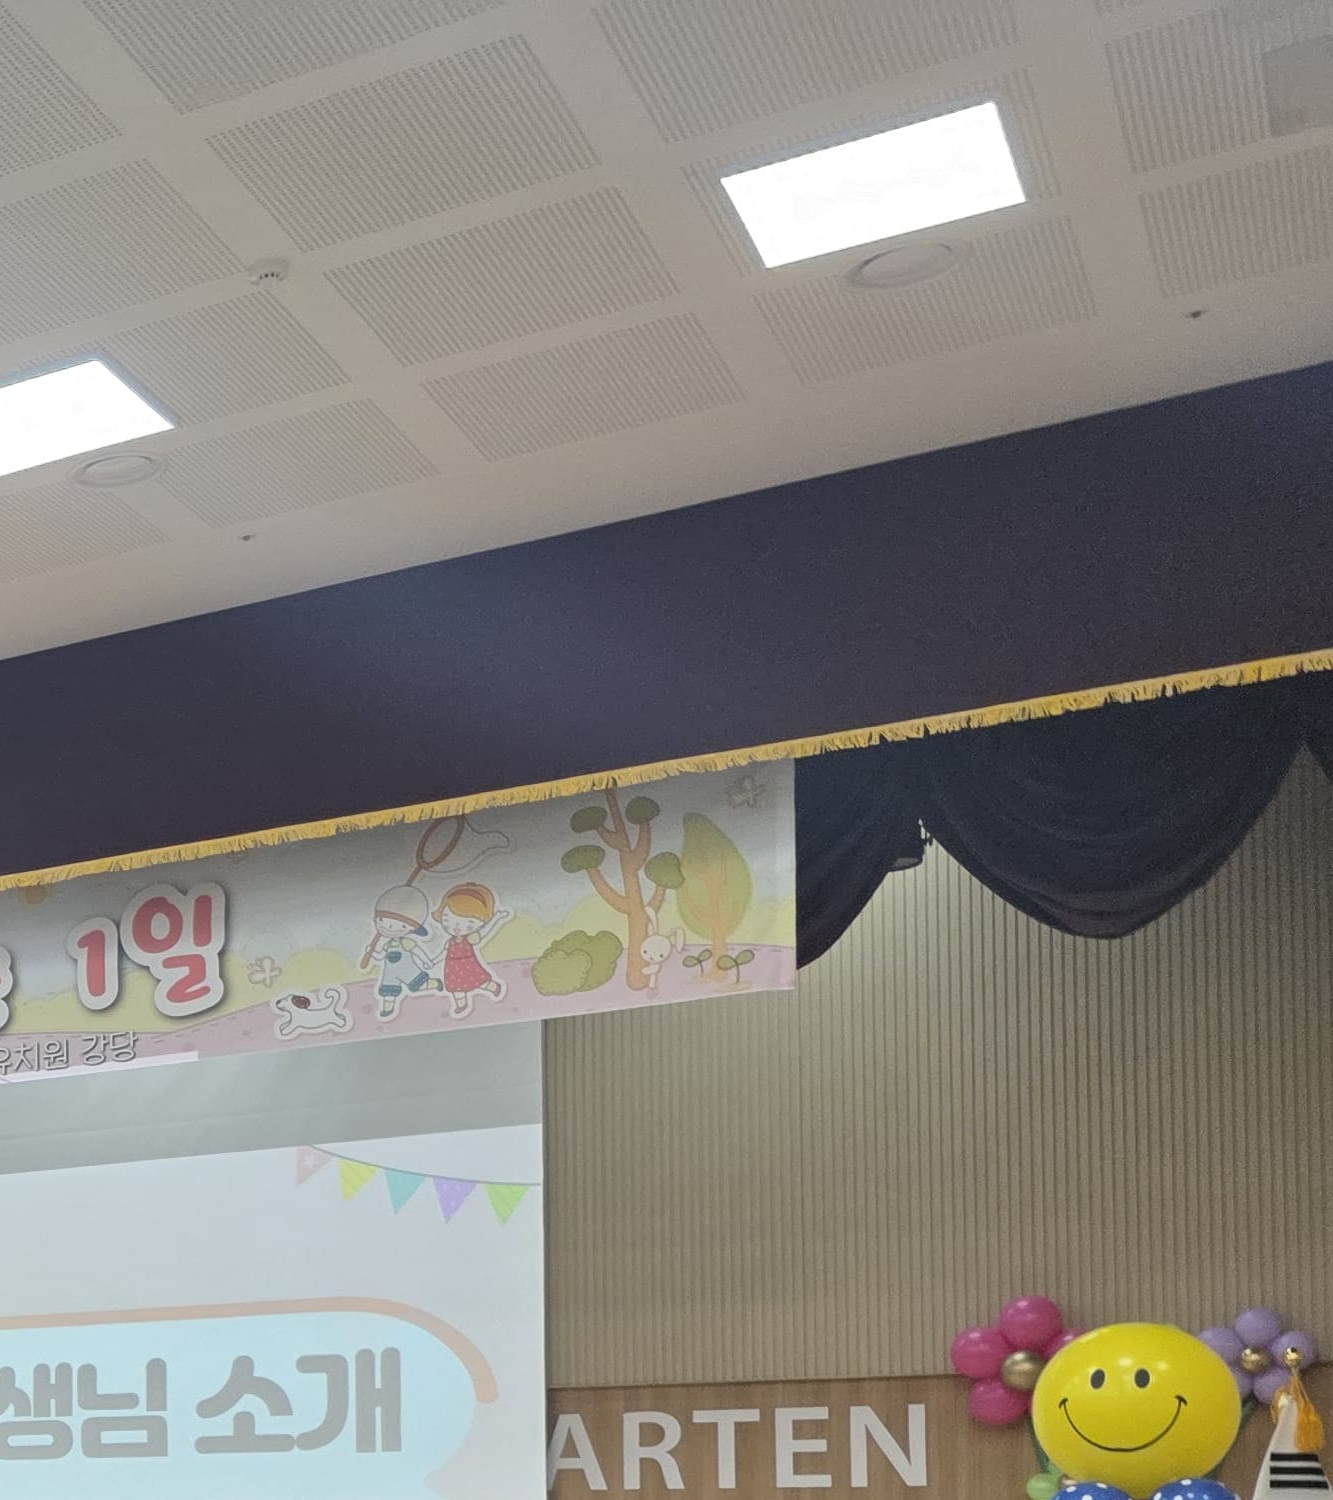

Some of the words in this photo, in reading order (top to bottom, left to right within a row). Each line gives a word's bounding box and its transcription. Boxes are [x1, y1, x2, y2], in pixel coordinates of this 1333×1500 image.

[75, 889, 216, 1010] 1일
[81, 1030, 139, 1066] 강당
[194, 1346, 404, 1456] 소개
